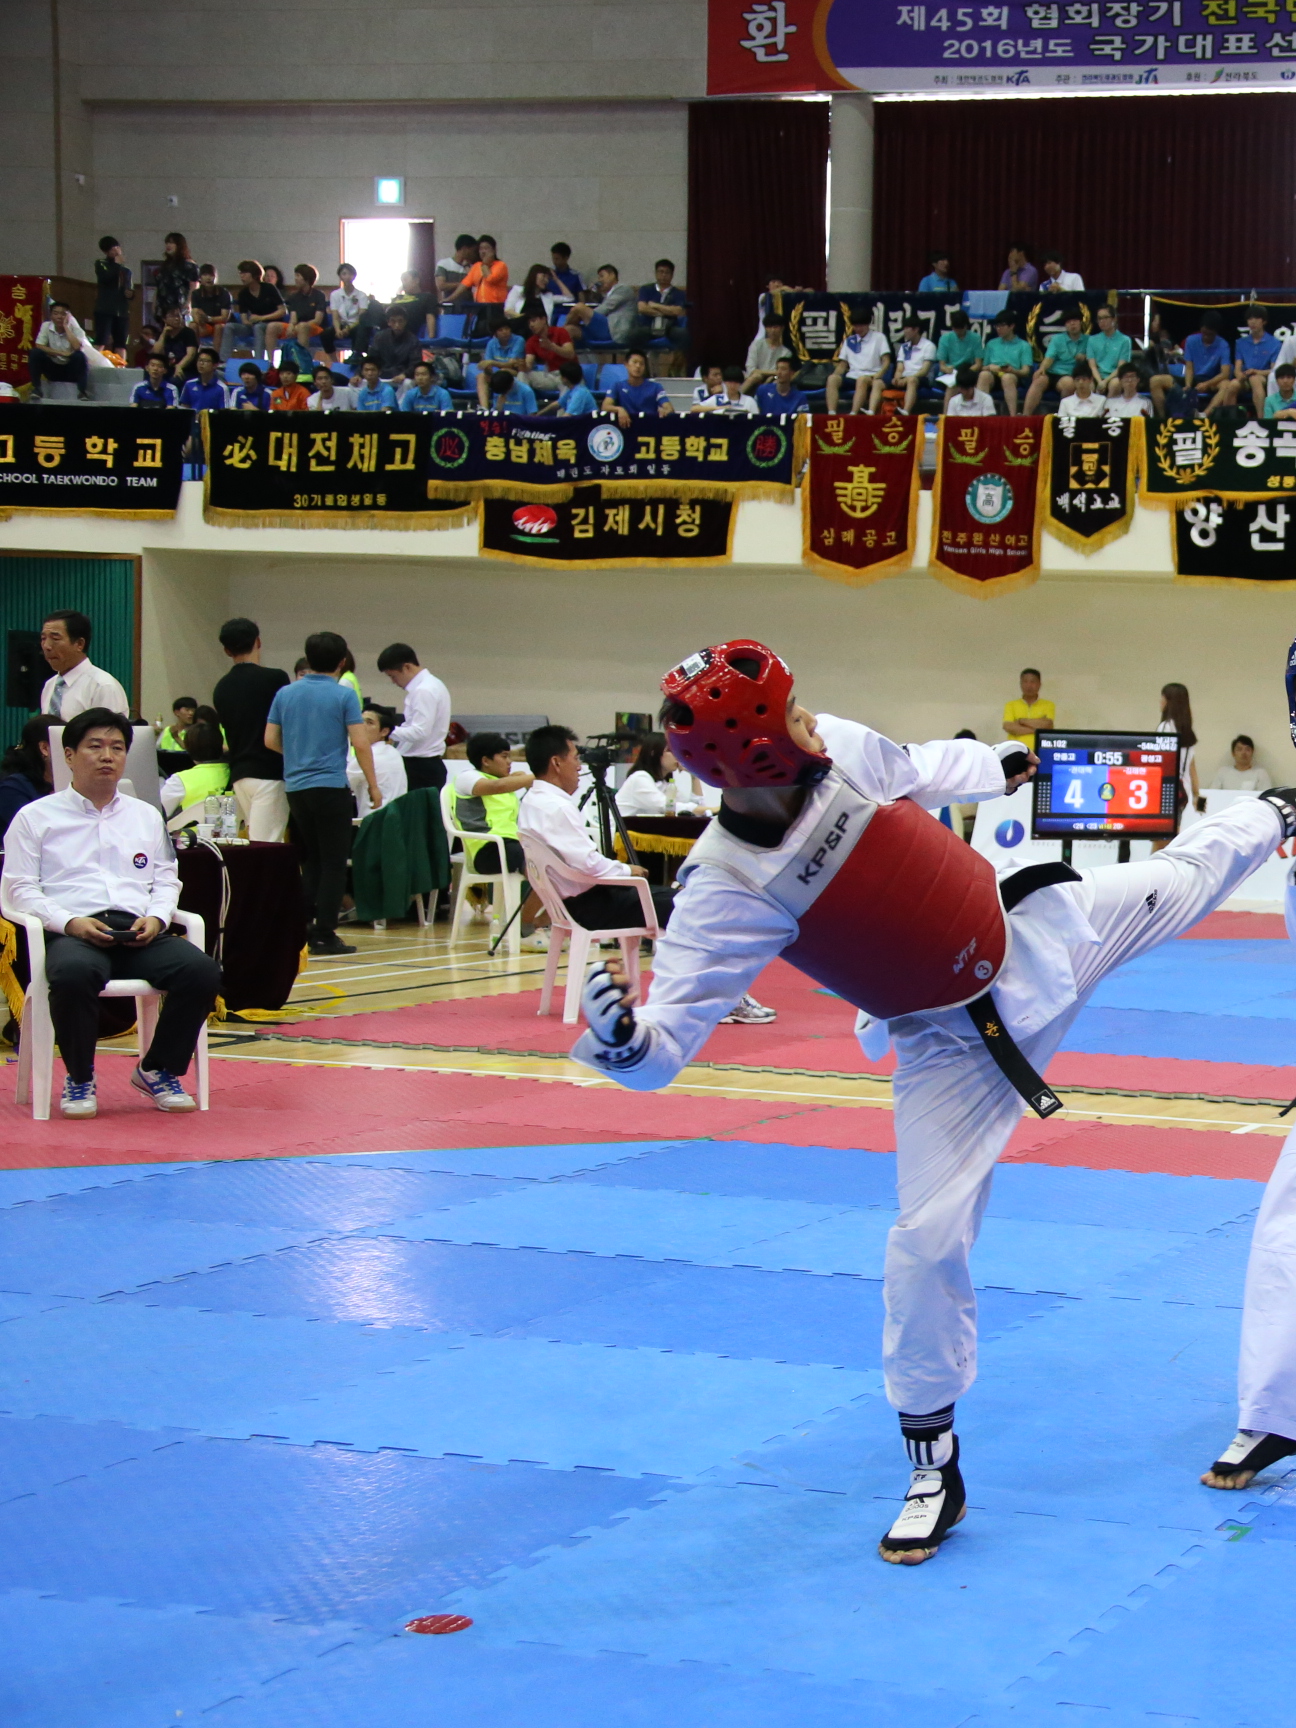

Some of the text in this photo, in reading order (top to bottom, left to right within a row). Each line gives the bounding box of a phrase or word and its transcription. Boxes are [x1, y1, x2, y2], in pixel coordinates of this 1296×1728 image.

[896, 5, 1009, 31] 제45회
[1024, 0, 1182, 29] 협회장기
[739, 0, 797, 63] 환
[942, 38, 1075, 59] 2016년도
[1006, 69, 1031, 86] KTA
[801, 309, 838, 350] 필
[824, 416, 904, 444] 필 승
[957, 427, 1036, 456] 필 승
[268, 431, 417, 473] 대전체고
[485, 435, 729, 466] 충남체육 고등학교
[1172, 430, 1203, 466] 필
[42, 474, 118, 486] TAEKWONDO
[126, 476, 157, 487] TEAM
[570, 501, 701, 539] 김제시청
[1094, 751, 1124, 766] 0:55
[1063, 779, 1085, 809] 4
[1128, 780, 1149, 810] 3
